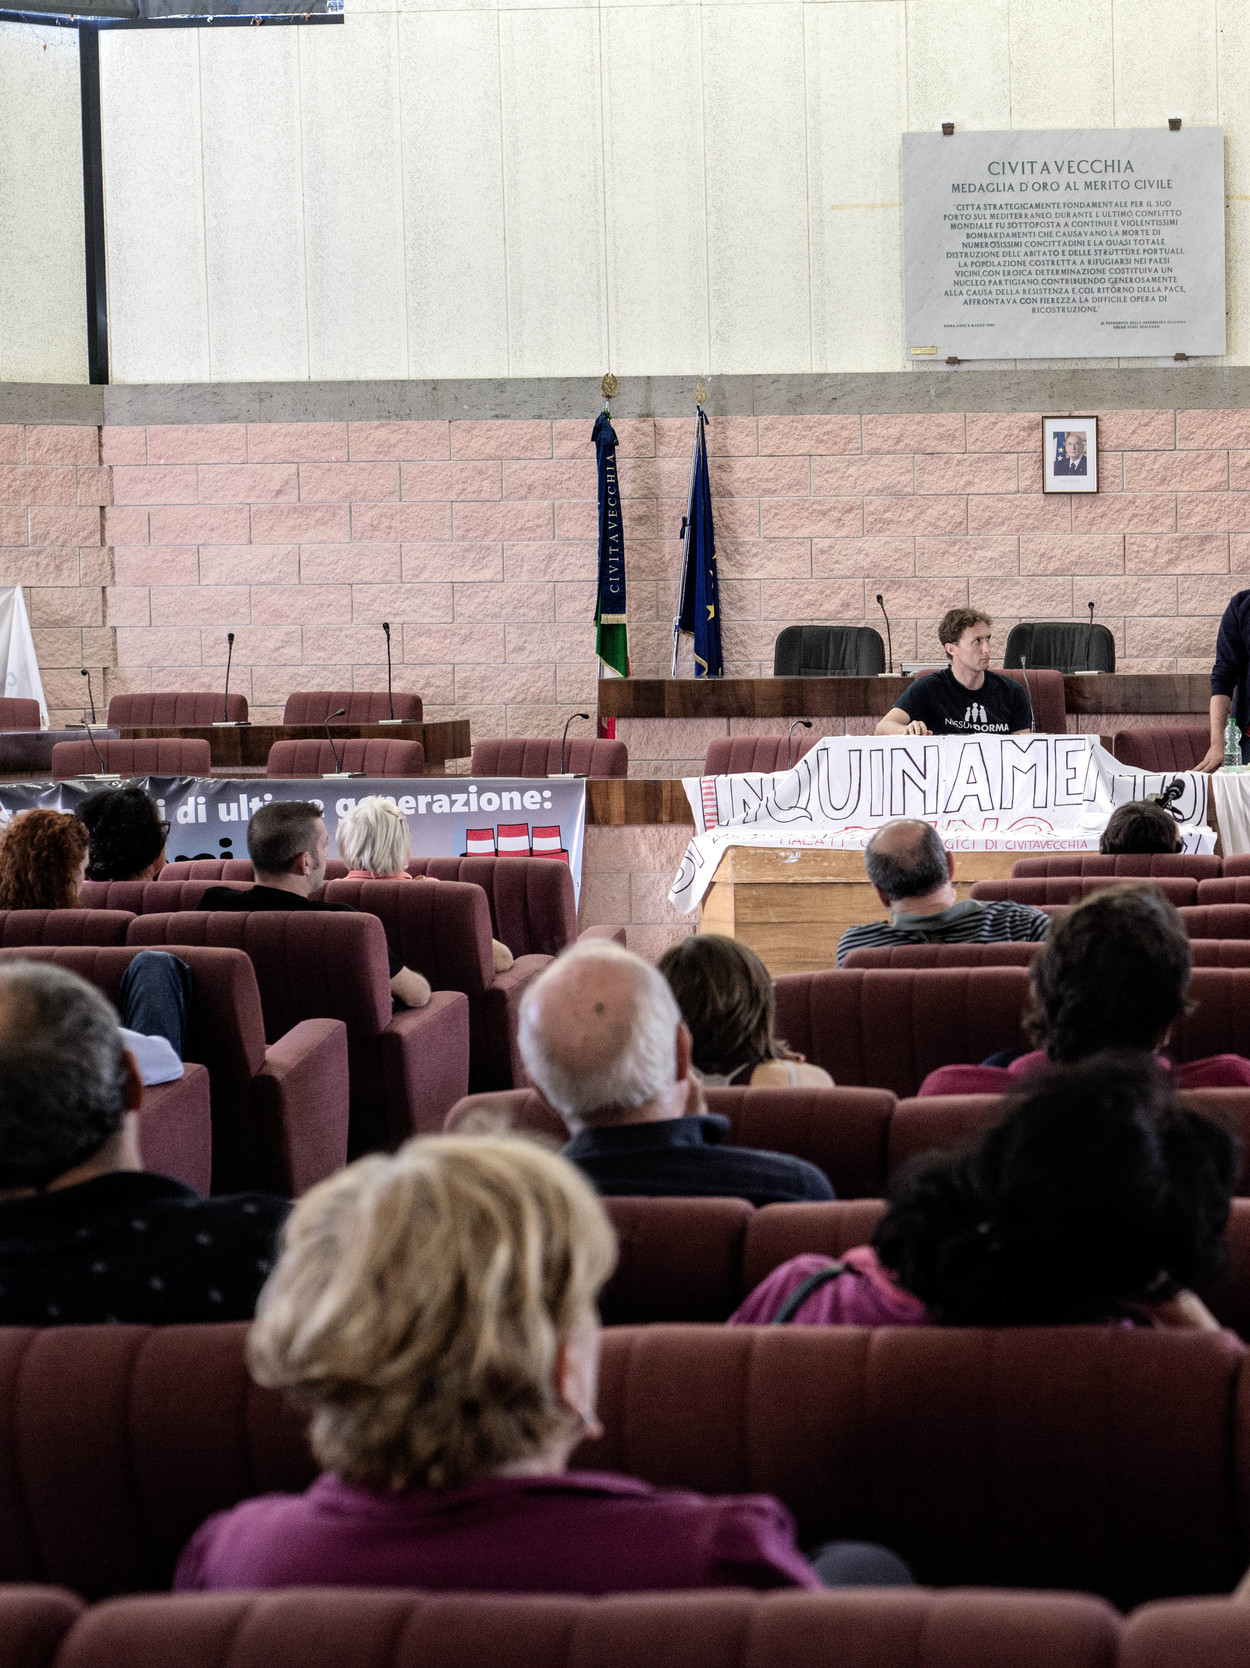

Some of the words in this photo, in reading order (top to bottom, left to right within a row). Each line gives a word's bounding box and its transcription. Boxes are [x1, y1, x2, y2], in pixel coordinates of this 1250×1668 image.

[988, 159, 1134, 176] CIVITAVECCHIA
[951, 182, 1015, 193] MEDAGLIA
[1020, 181, 1060, 192] D'ORO
[1064, 181, 1080, 191] AL
[1084, 180, 1130, 190] MERITO
[1134, 179, 1173, 190] CIVILE
[983, 202, 1060, 211] STRATEGICAMENTE
[1063, 201, 1128, 209] FONDAMENTALE
[1130, 200, 1144, 208] PER
[943, 213, 971, 221] PORTO
[1135, 209, 1182, 217] CONFLITTO
[950, 222, 993, 230] MONDIALE
[1007, 221, 1061, 229] SOTTOPOSTA
[1071, 220, 1112, 228] CONTINUI
[1121, 219, 1178, 227] VIOLENTISSIMI
[966, 231, 1036, 239] BOMBARDAMENTI
[1055, 230, 1107, 238] CAUSAVANO
[1121, 229, 1150, 237] MORTE
[962, 241, 1022, 249] NUMEROSISSIMI
[1024, 240, 1085, 248] CONCITTADINI
[1093, 239, 1104, 247] LA
[1105, 239, 1131, 247] QUASI
[1133, 238, 1165, 246] TOTALE
[946, 251, 1000, 259] DISTRUZIONE
[1023, 249, 1060, 257] ABITATO
[1068, 249, 1091, 257] DELLE
[1093, 248, 1141, 256] STRUTTURE
[958, 260, 968, 268] LA
[970, 260, 1027, 268] POPOLAZIONE
[1029, 259, 1077, 267] COSTRETTA
[1079, 258, 1085, 266] A
[1087, 258, 1132, 266] RIFUGIARSI
[1002, 269, 1033, 277] EROICA
[1035, 268, 1107, 276] DETERMINAZIONE
[1109, 267, 1159, 275] COSTITUIVA
[1041, 277, 1106, 285] CONTRIBUENDO
[1108, 276, 1178, 284] GENEROSAMENTE
[943, 289, 964, 297] ALLA
[995, 288, 1020, 296] DELLA
[1022, 287, 1069, 295] RESISTENZA
[1096, 286, 1135, 294] RITORNO
[1137, 285, 1161, 293] DELLA
[963, 298, 1017, 306] AFFRONTAVA
[1019, 297, 1038, 305] CON
[1040, 296, 1077, 304] FIEREZZA
[1079, 296, 1089, 304] LA
[1130, 295, 1156, 303] OPERA
[606, 453, 621, 594] CIVITAVECCHIA
[176, 796, 207, 825] di
[335, 785, 552, 822] gerazione:
[985, 839, 998, 850] DI
[1005, 839, 1088, 851] CIVITAVECCHIA
